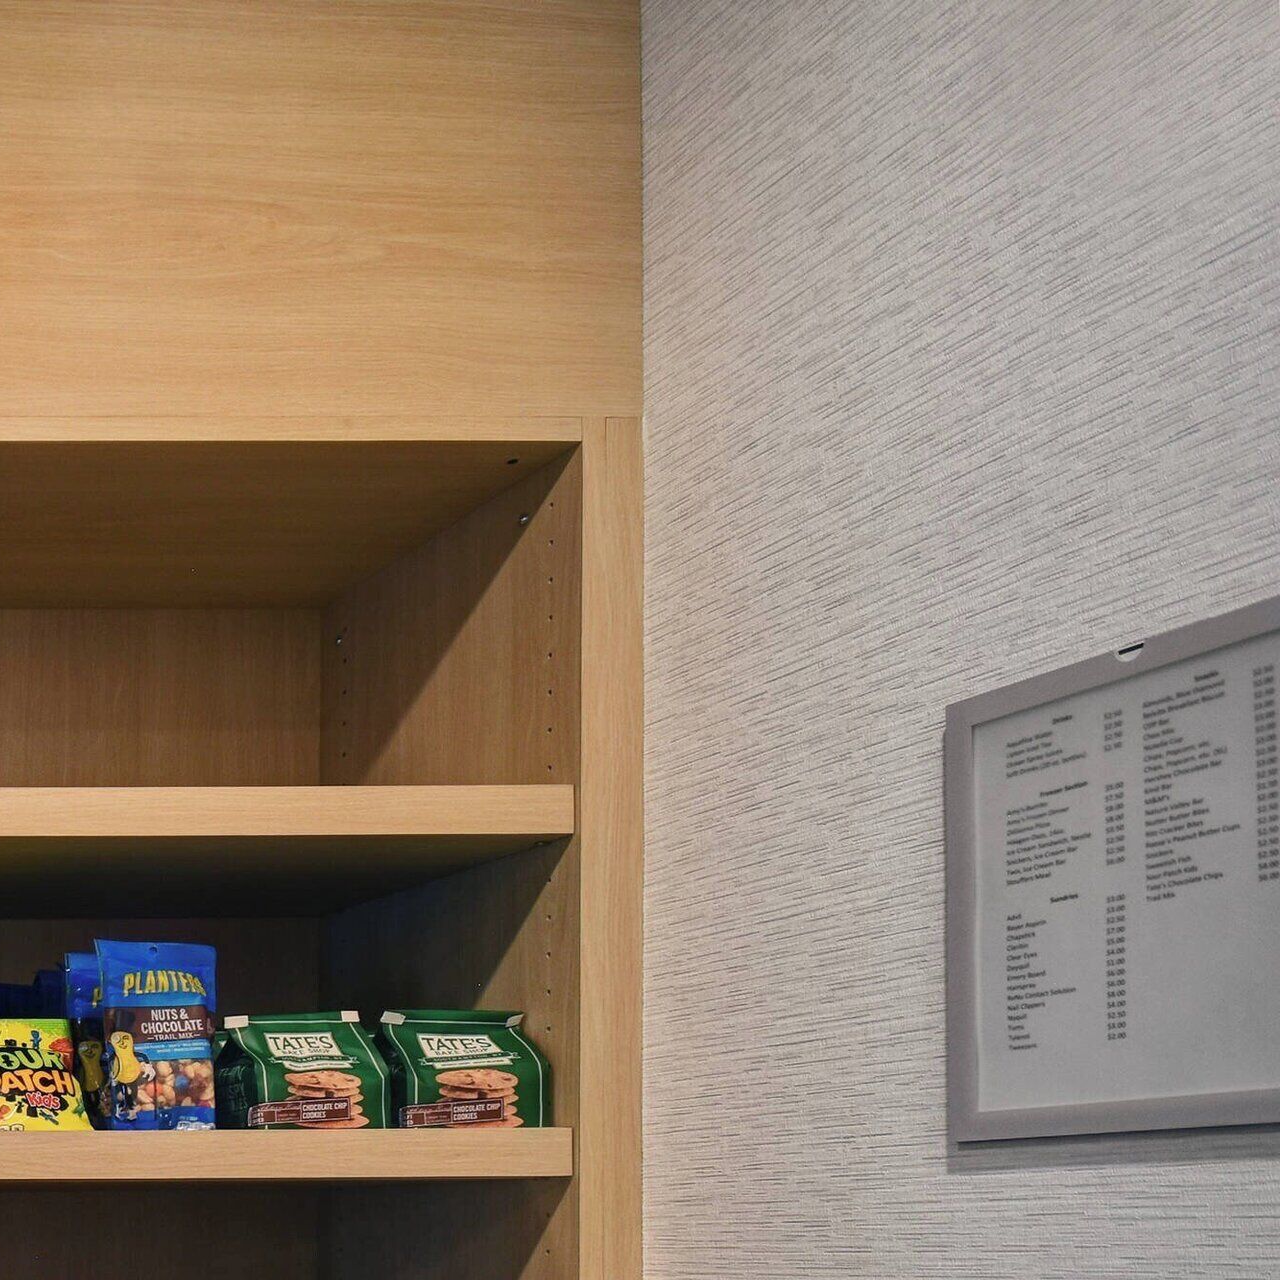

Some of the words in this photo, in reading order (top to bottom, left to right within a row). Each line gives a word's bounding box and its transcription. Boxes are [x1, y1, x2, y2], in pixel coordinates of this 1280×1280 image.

[150, 1009, 179, 1021] NUTS
[180, 1008, 189, 1020] &
[141, 1019, 204, 1034] CHOCOLATE
[268, 1036, 334, 1050] TATE'S
[421, 1037, 492, 1051] TATE'S
[25, 1091, 61, 1109] Kids
[333, 1101, 348, 1110] CHIP
